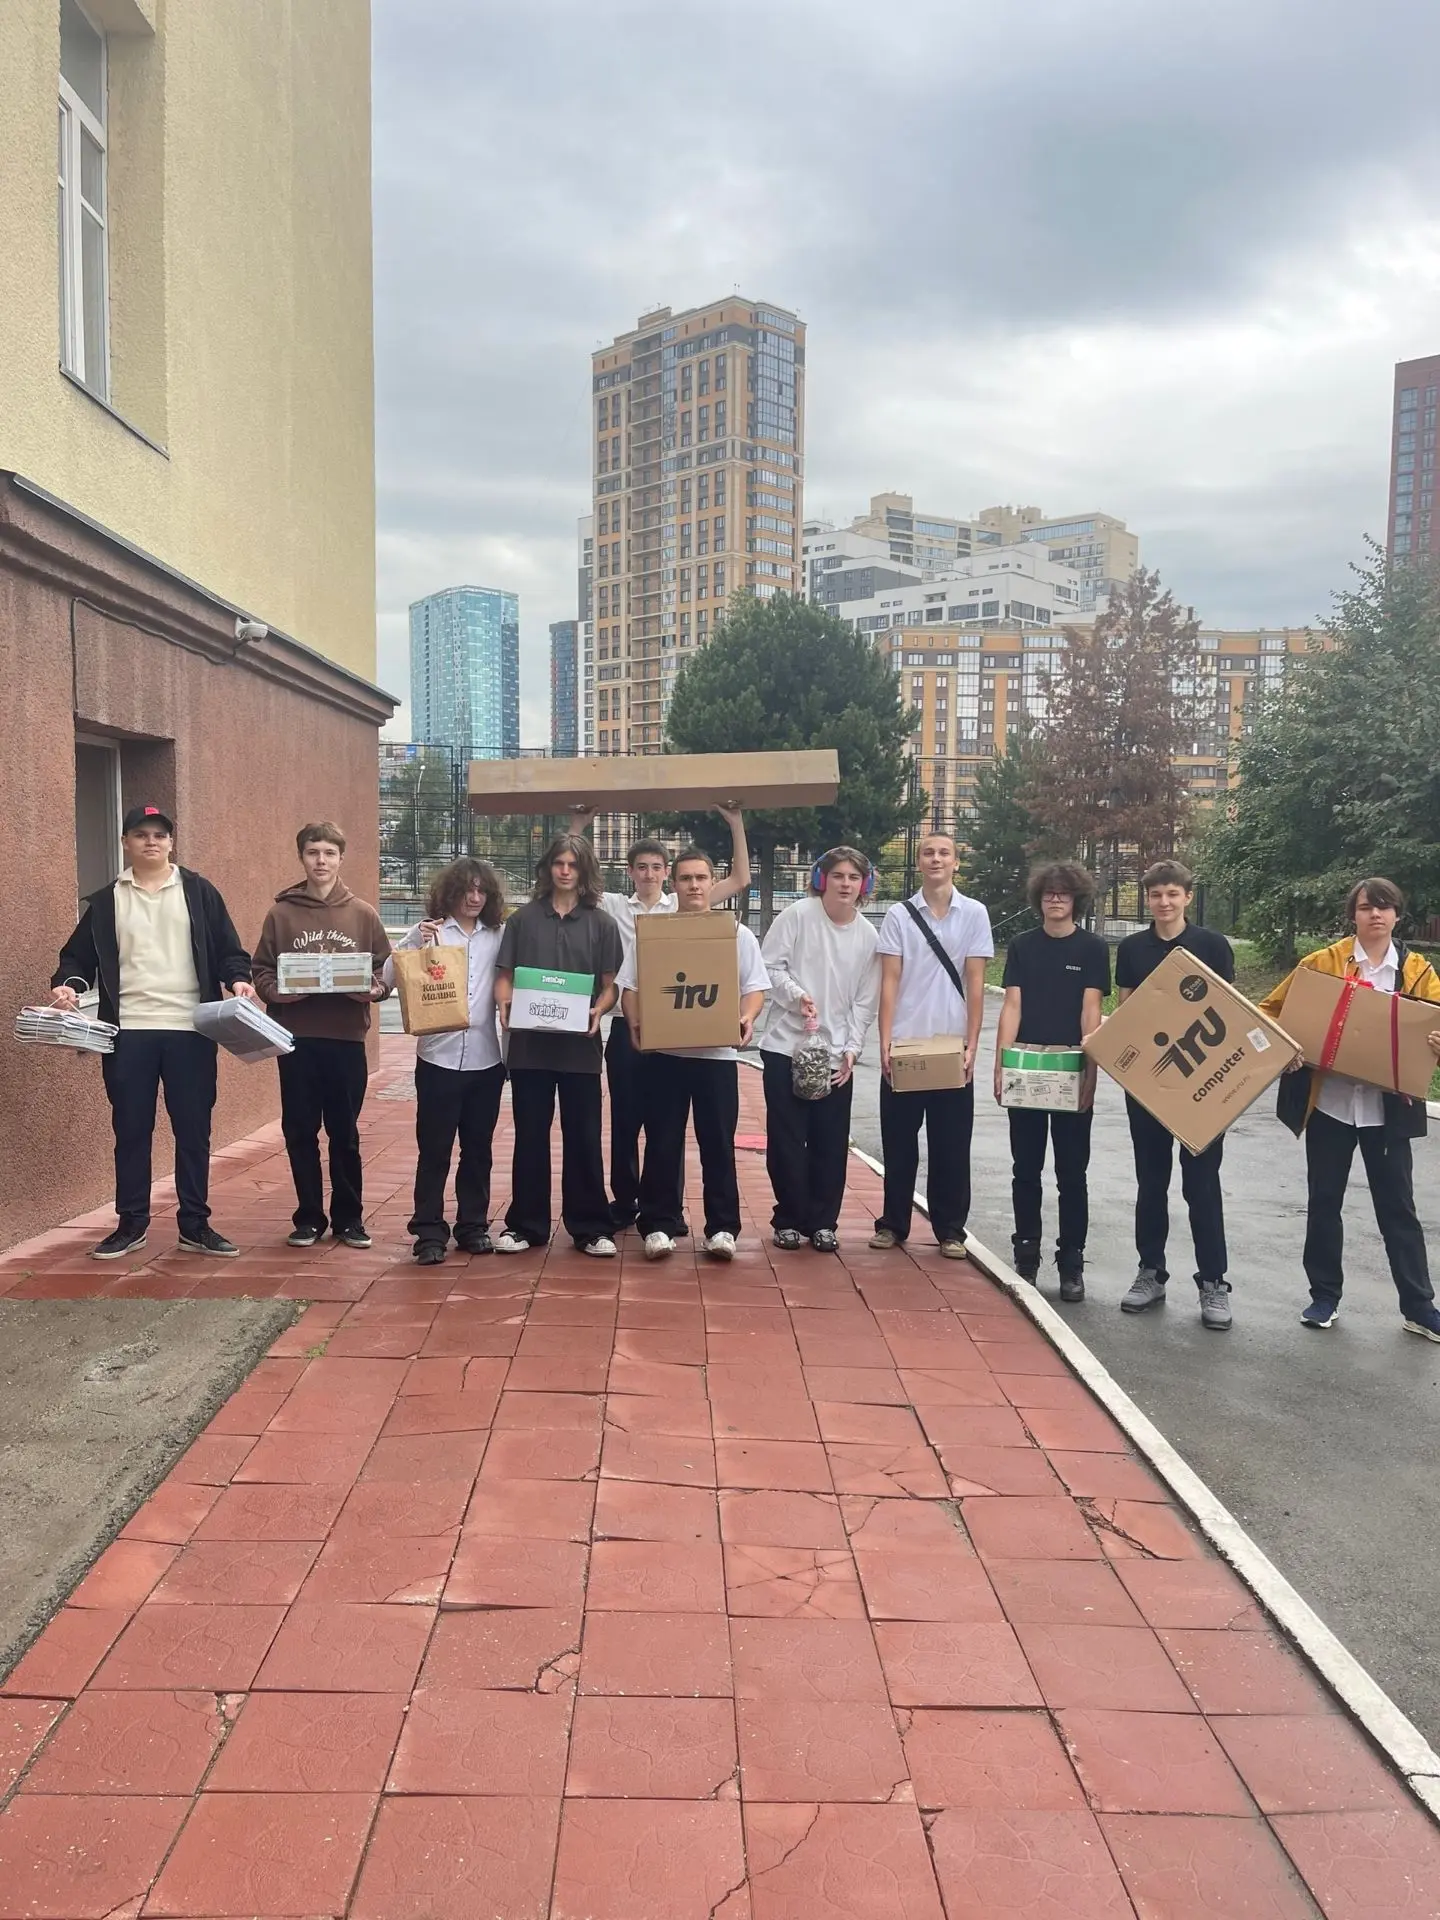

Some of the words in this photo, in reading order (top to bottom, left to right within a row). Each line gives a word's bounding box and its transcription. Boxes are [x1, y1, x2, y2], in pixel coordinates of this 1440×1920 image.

[293, 929, 325, 949] Wild
[326, 929, 357, 948] things
[421, 990, 457, 1002] Малина
[422, 981, 456, 993] Калина
[660, 971, 719, 1010] iru
[1182, 988, 1195, 999] 3
[529, 1002, 569, 1020] SvetoCopy
[1151, 1005, 1227, 1079] iru
[1192, 1046, 1246, 1103] computer
